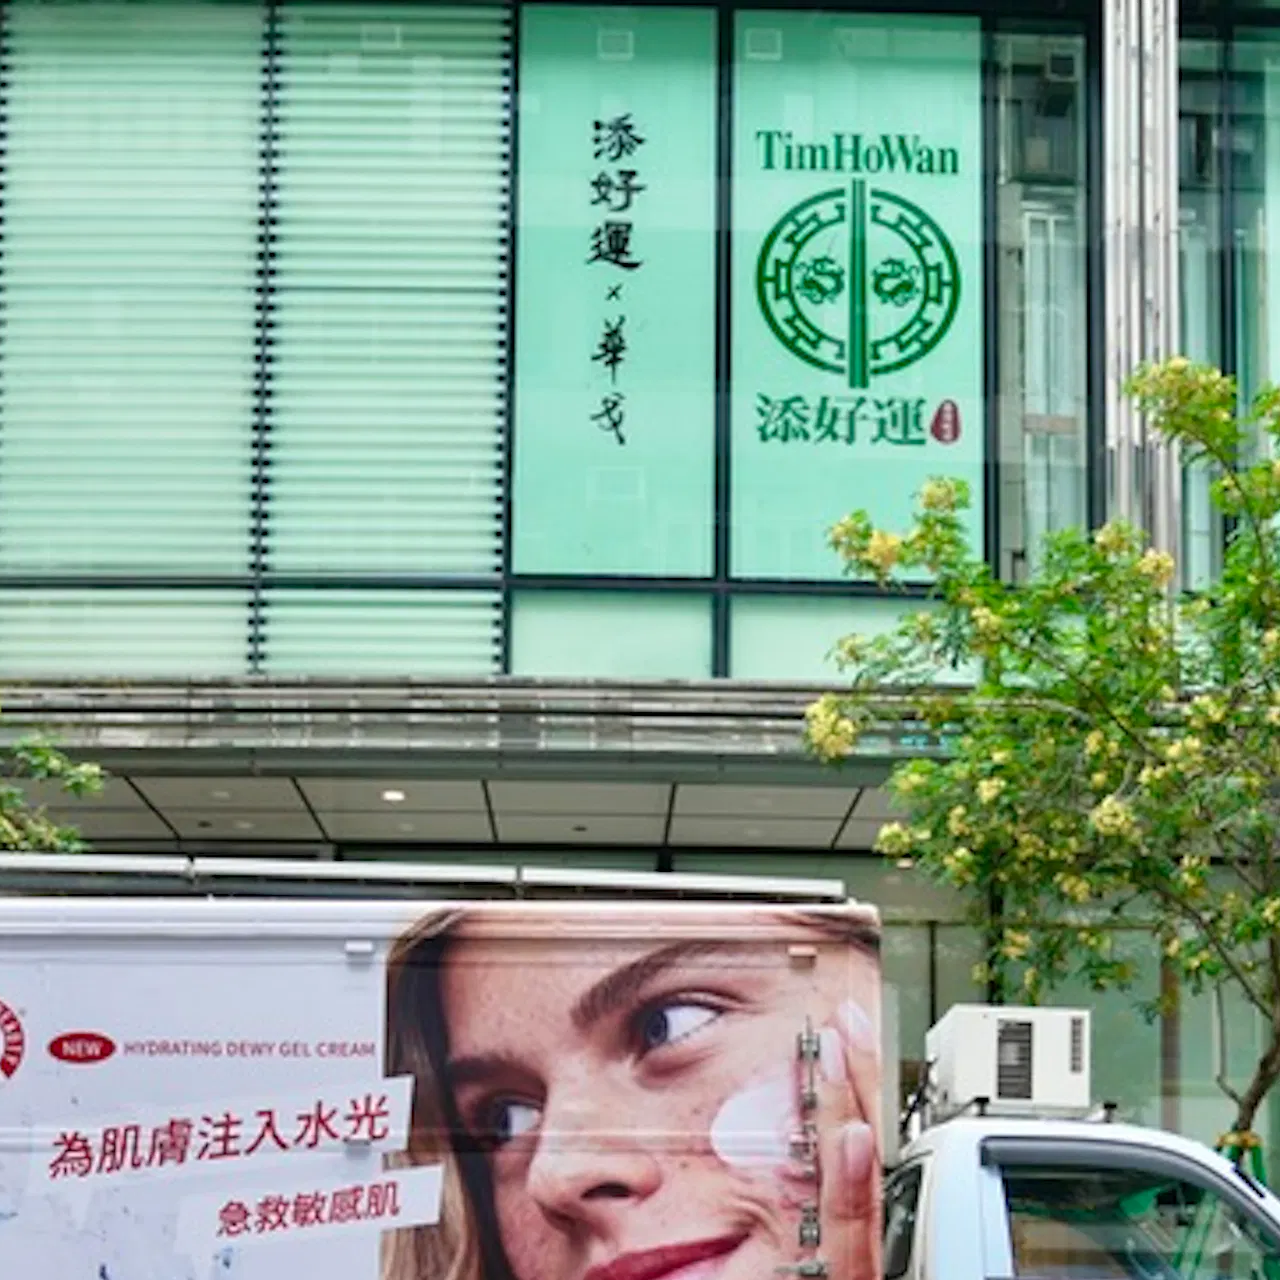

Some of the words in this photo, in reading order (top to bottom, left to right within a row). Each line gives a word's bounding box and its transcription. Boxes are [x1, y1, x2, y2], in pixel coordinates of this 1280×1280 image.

[755, 130, 960, 175] TimHoWan
[755, 393, 927, 446] 添好運
[61, 1039, 104, 1057] NEW
[123, 1040, 221, 1058] HYDRATING
[226, 1040, 274, 1058] DEWY
[279, 1040, 311, 1058] GEL
[316, 1041, 376, 1058] CREAM
[48, 1092, 391, 1181] 為肌膚注入水光
[216, 1181, 401, 1239] 急救敏感肌
